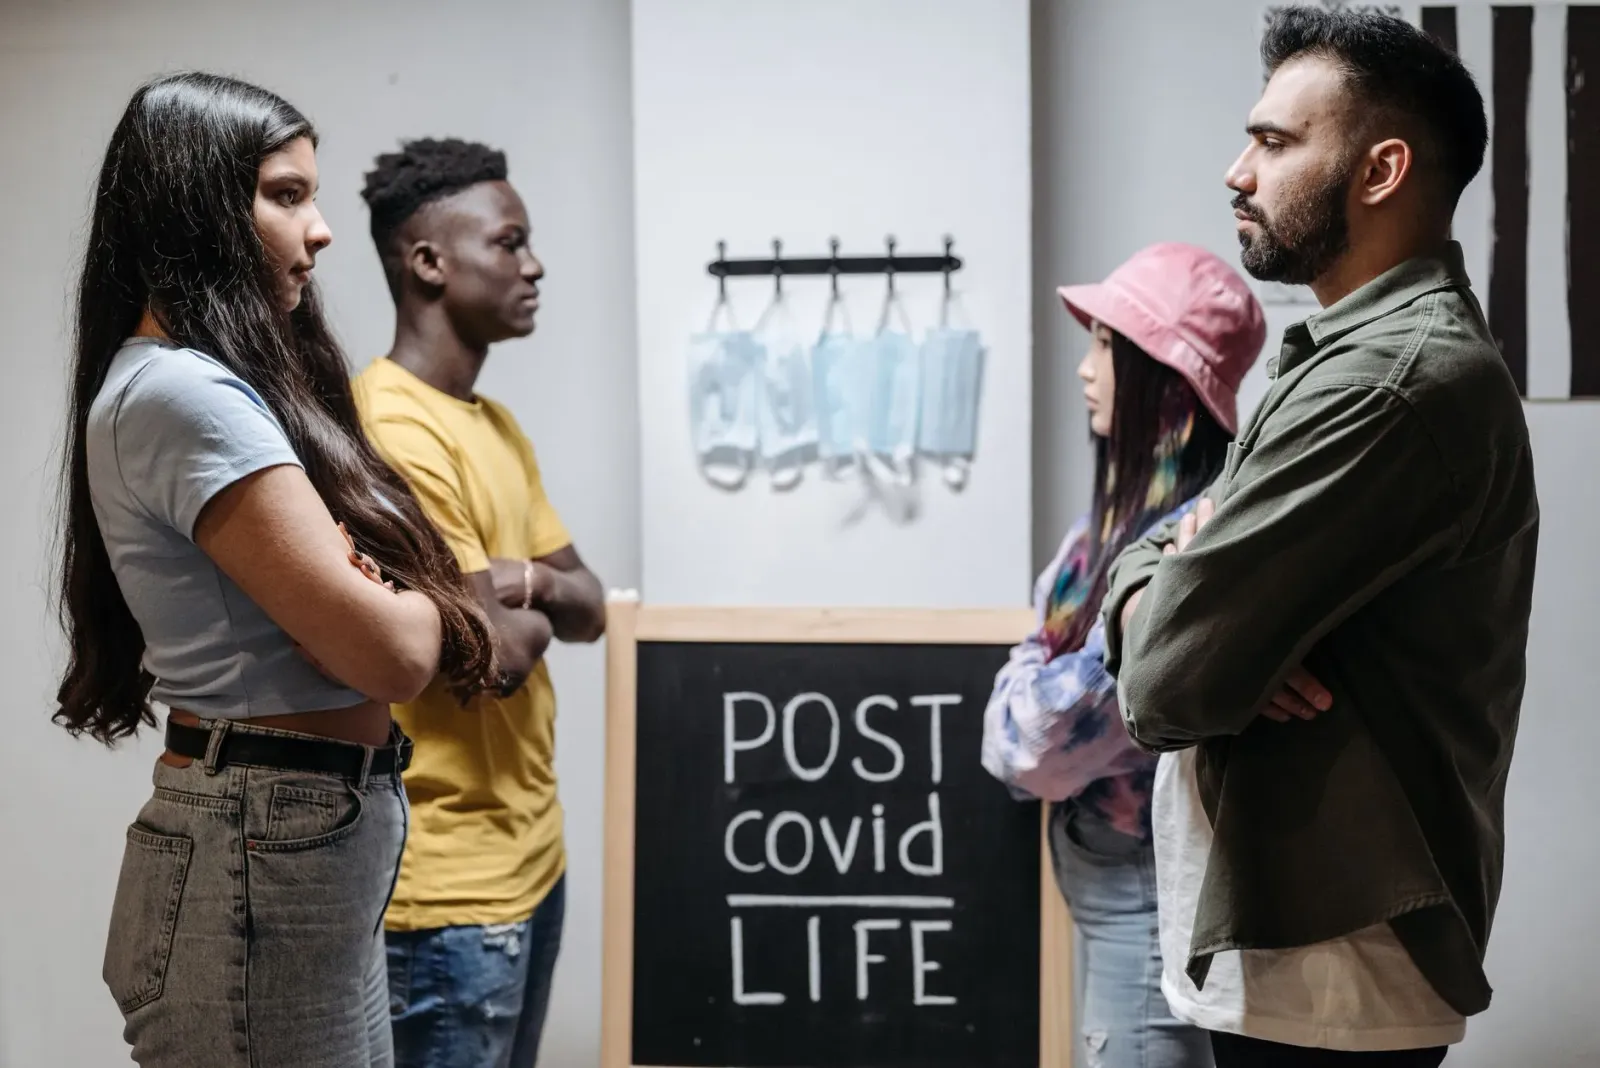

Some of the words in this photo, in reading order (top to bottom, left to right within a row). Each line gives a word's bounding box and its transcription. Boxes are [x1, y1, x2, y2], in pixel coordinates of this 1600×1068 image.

[723, 692, 962, 783] POST
[725, 792, 943, 875] covid
[731, 916, 957, 1005] LIFE
